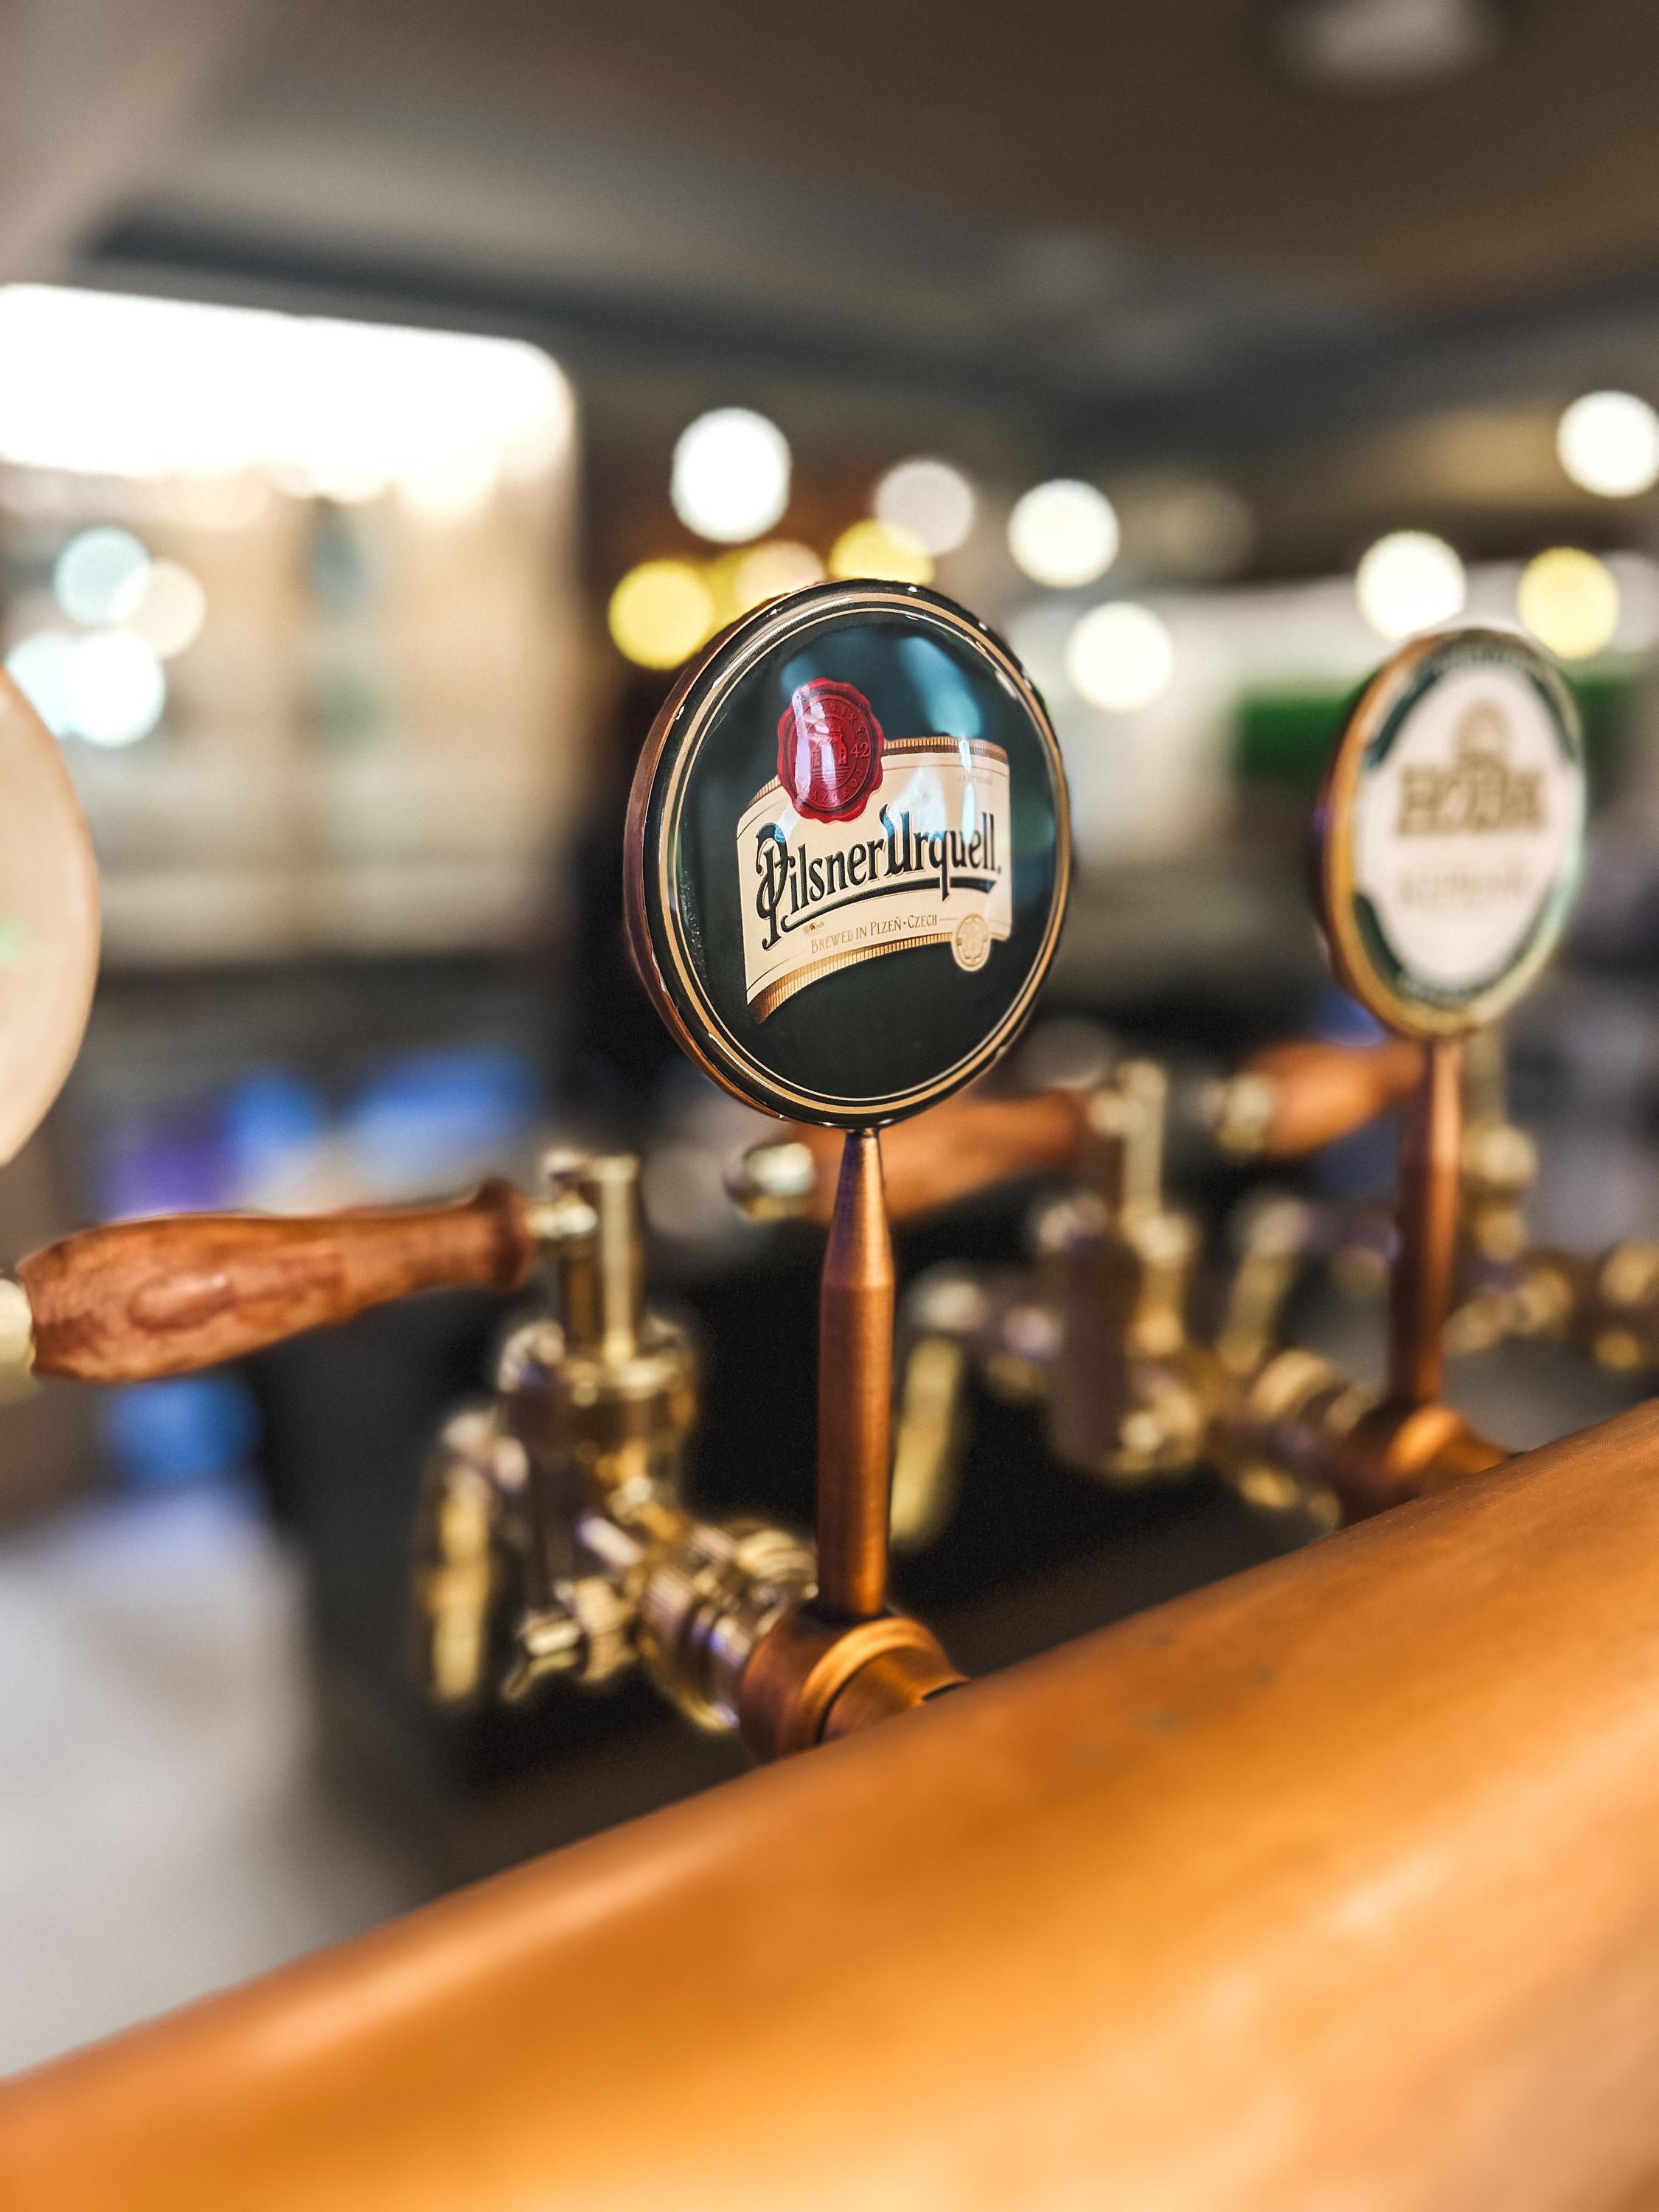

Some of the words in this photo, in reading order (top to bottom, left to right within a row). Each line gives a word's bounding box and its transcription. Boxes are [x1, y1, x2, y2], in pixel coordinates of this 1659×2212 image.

[850, 742, 869, 759] 42
[755, 821, 885, 951] Pilsner
[810, 930, 854, 955] BREWED
[855, 925, 868, 940] IN
